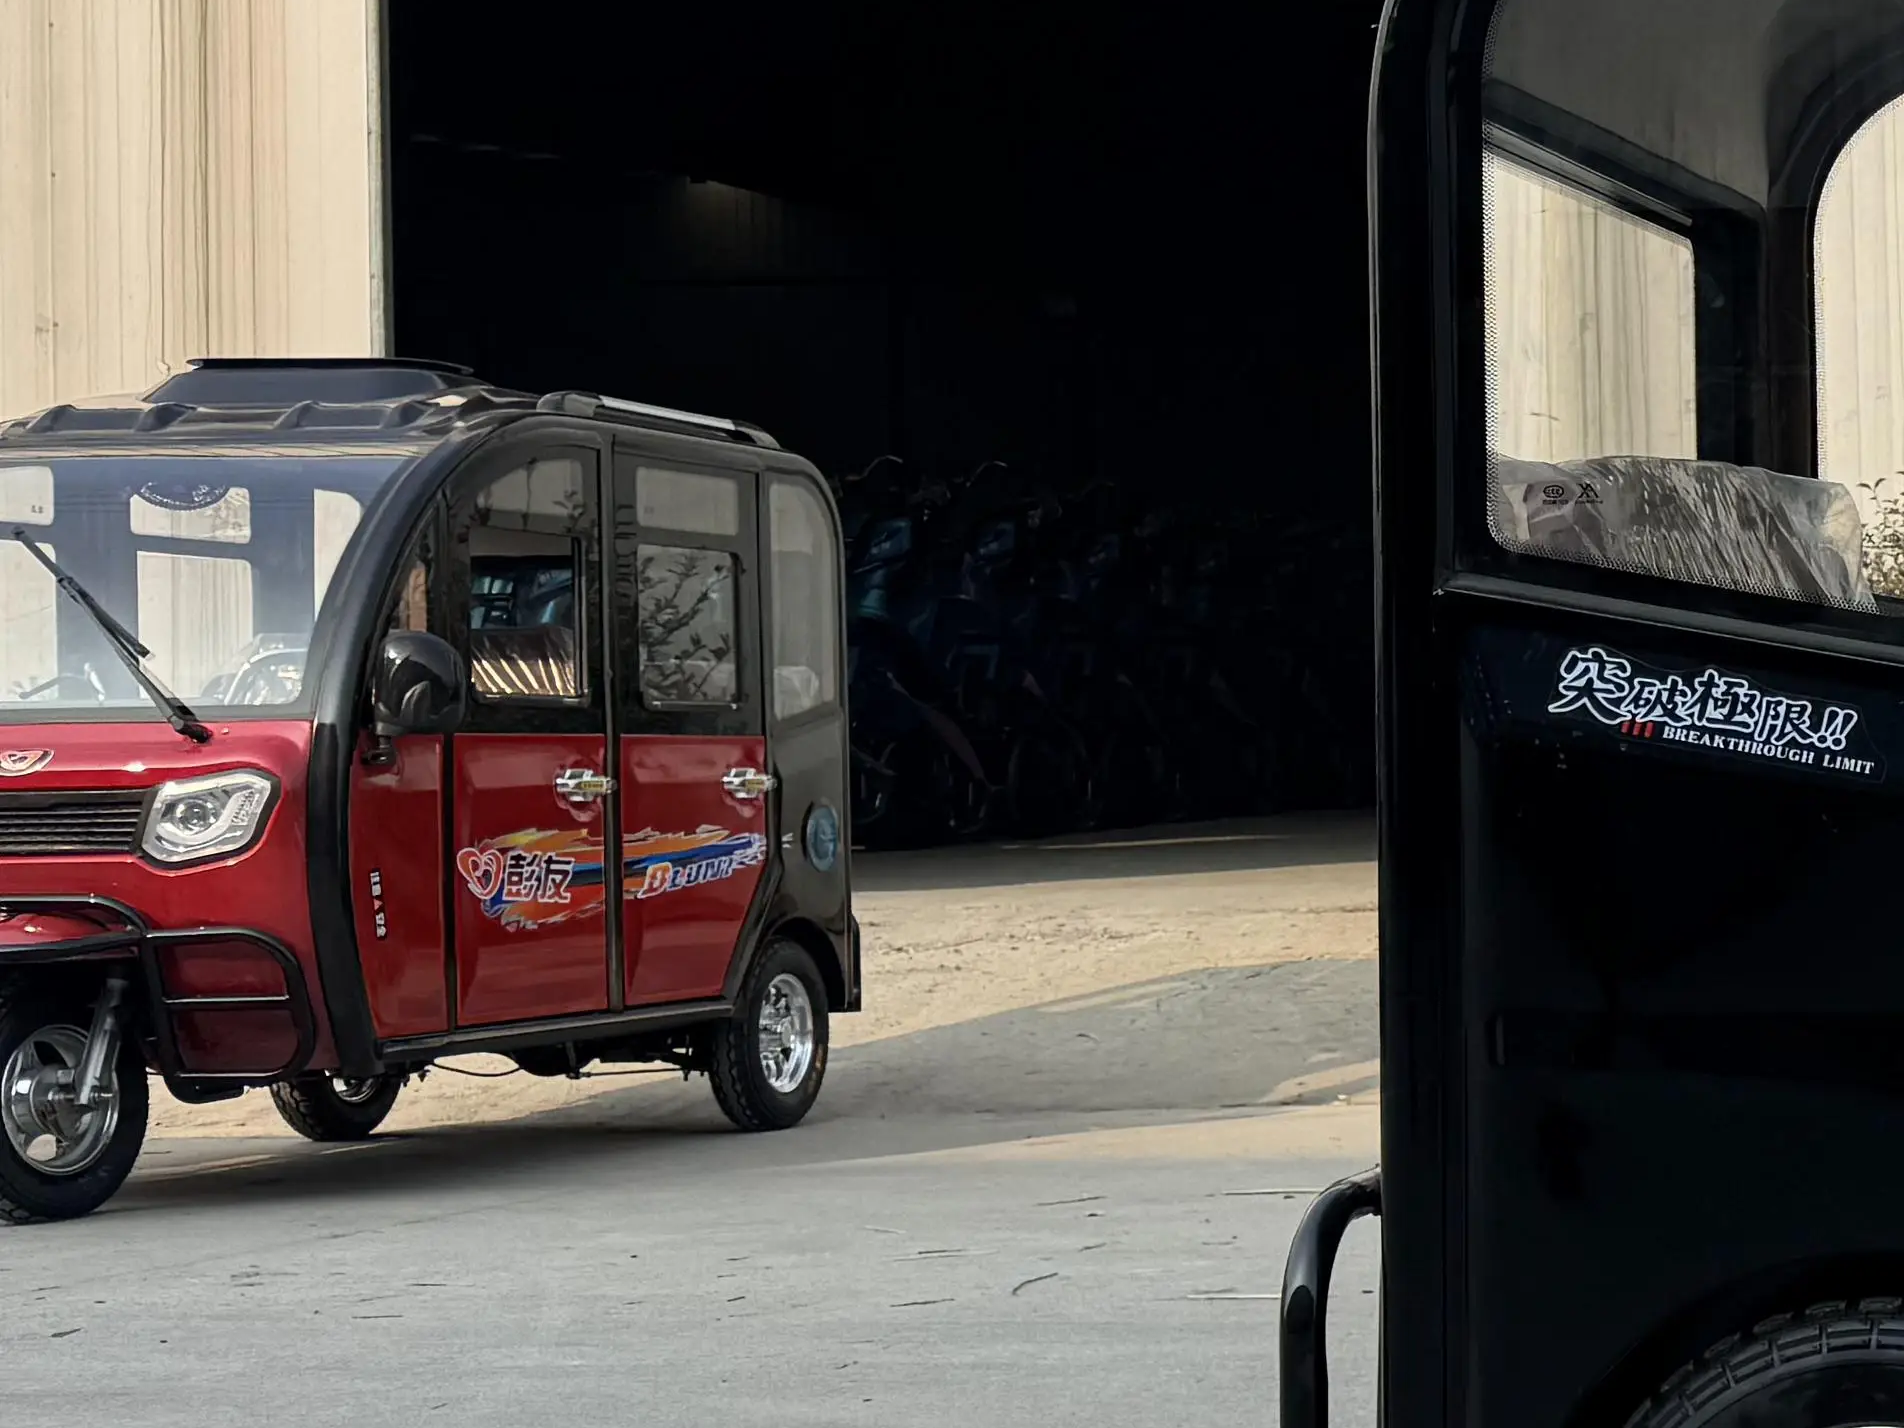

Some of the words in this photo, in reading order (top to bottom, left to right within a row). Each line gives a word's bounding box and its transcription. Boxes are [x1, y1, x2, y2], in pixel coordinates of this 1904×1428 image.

[1662, 726, 1814, 765] BREAKTHROUGH
[1823, 753, 1875, 775] LIMIT
[502, 851, 575, 903] 彭友
